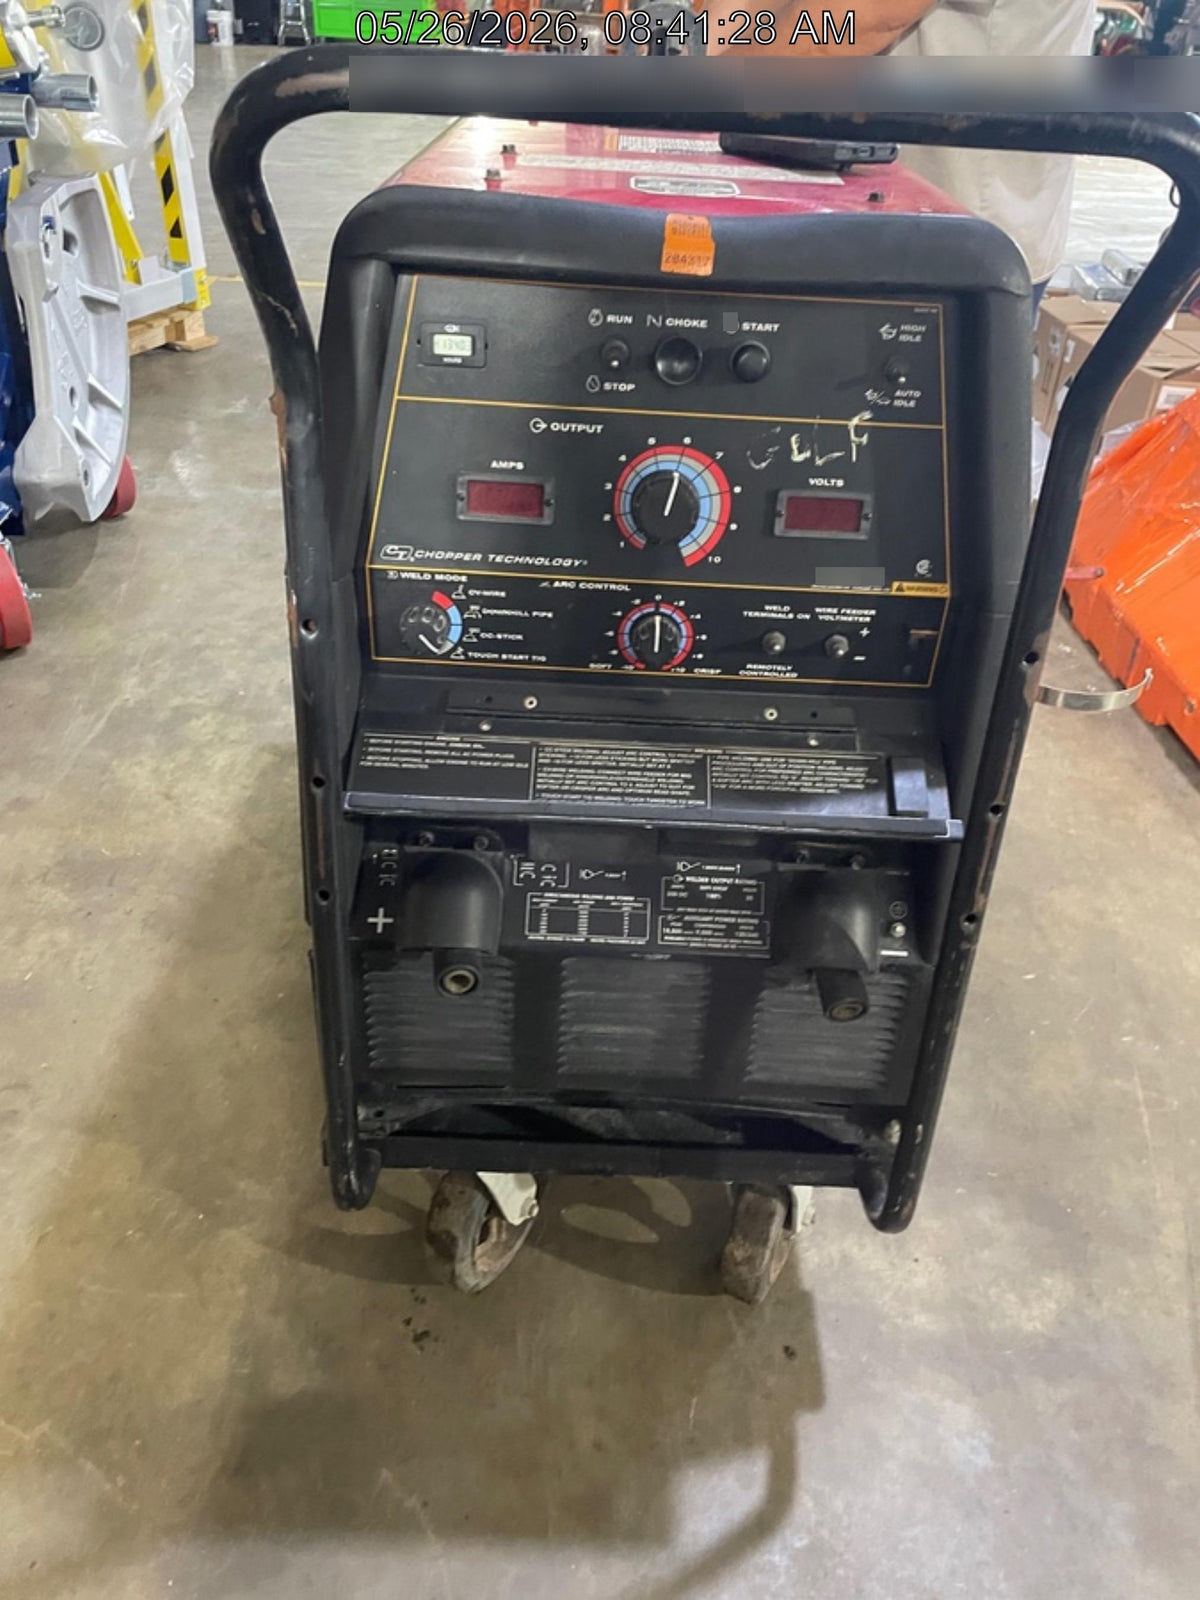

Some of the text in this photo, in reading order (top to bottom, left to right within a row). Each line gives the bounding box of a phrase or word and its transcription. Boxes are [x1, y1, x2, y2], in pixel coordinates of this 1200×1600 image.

[606, 314, 633, 324] RUN
[665, 318, 709, 329] CHOKE
[741, 322, 781, 333] START
[900, 324, 927, 333] HIGH
[899, 334, 922, 342] IDLE
[603, 382, 636, 392] STOP
[894, 389, 922, 398] AUTO
[893, 399, 917, 408] IDLE
[550, 422, 604, 434] OUTPUT
[490, 460, 525, 470] AMPS
[808, 478, 845, 488] VOLTS
[414, 550, 483, 562] CHOPPER
[399, 572, 468, 582] WELD MODE
[552, 581, 632, 591] ARC CONTROL
[764, 604, 791, 612] WELD
[814, 607, 877, 616] WIRE FEEDER
[742, 611, 794, 620] TERMINALS
[818, 614, 872, 623] VOLTMETER
[746, 663, 793, 672] REMOTELY
[738, 670, 799, 678] CONTROLLED
